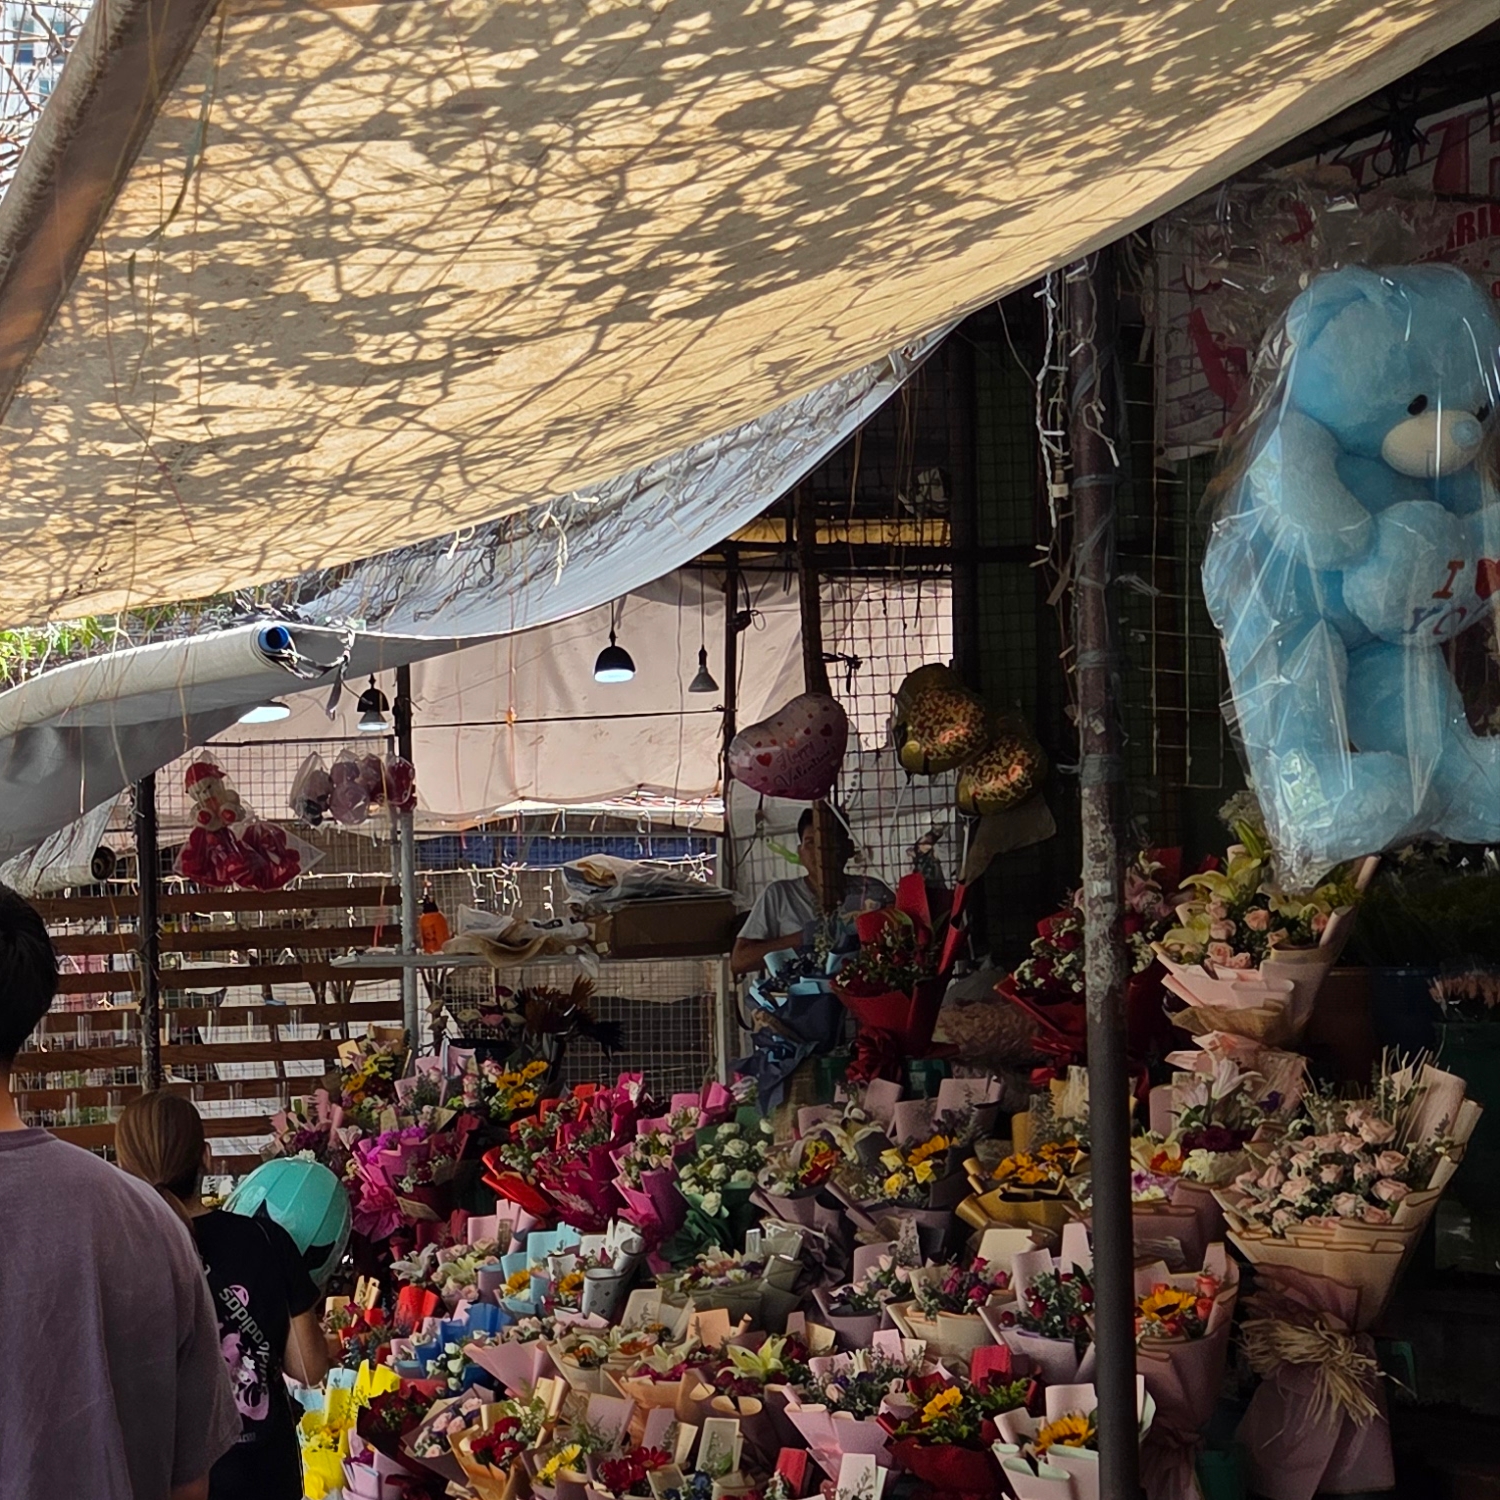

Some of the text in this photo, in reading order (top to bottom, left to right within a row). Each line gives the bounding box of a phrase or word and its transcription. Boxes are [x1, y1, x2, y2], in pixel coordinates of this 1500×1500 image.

[1432, 559, 1466, 600] I
[776, 741, 816, 771] Happy
[219, 1287, 266, 1343] adidas
